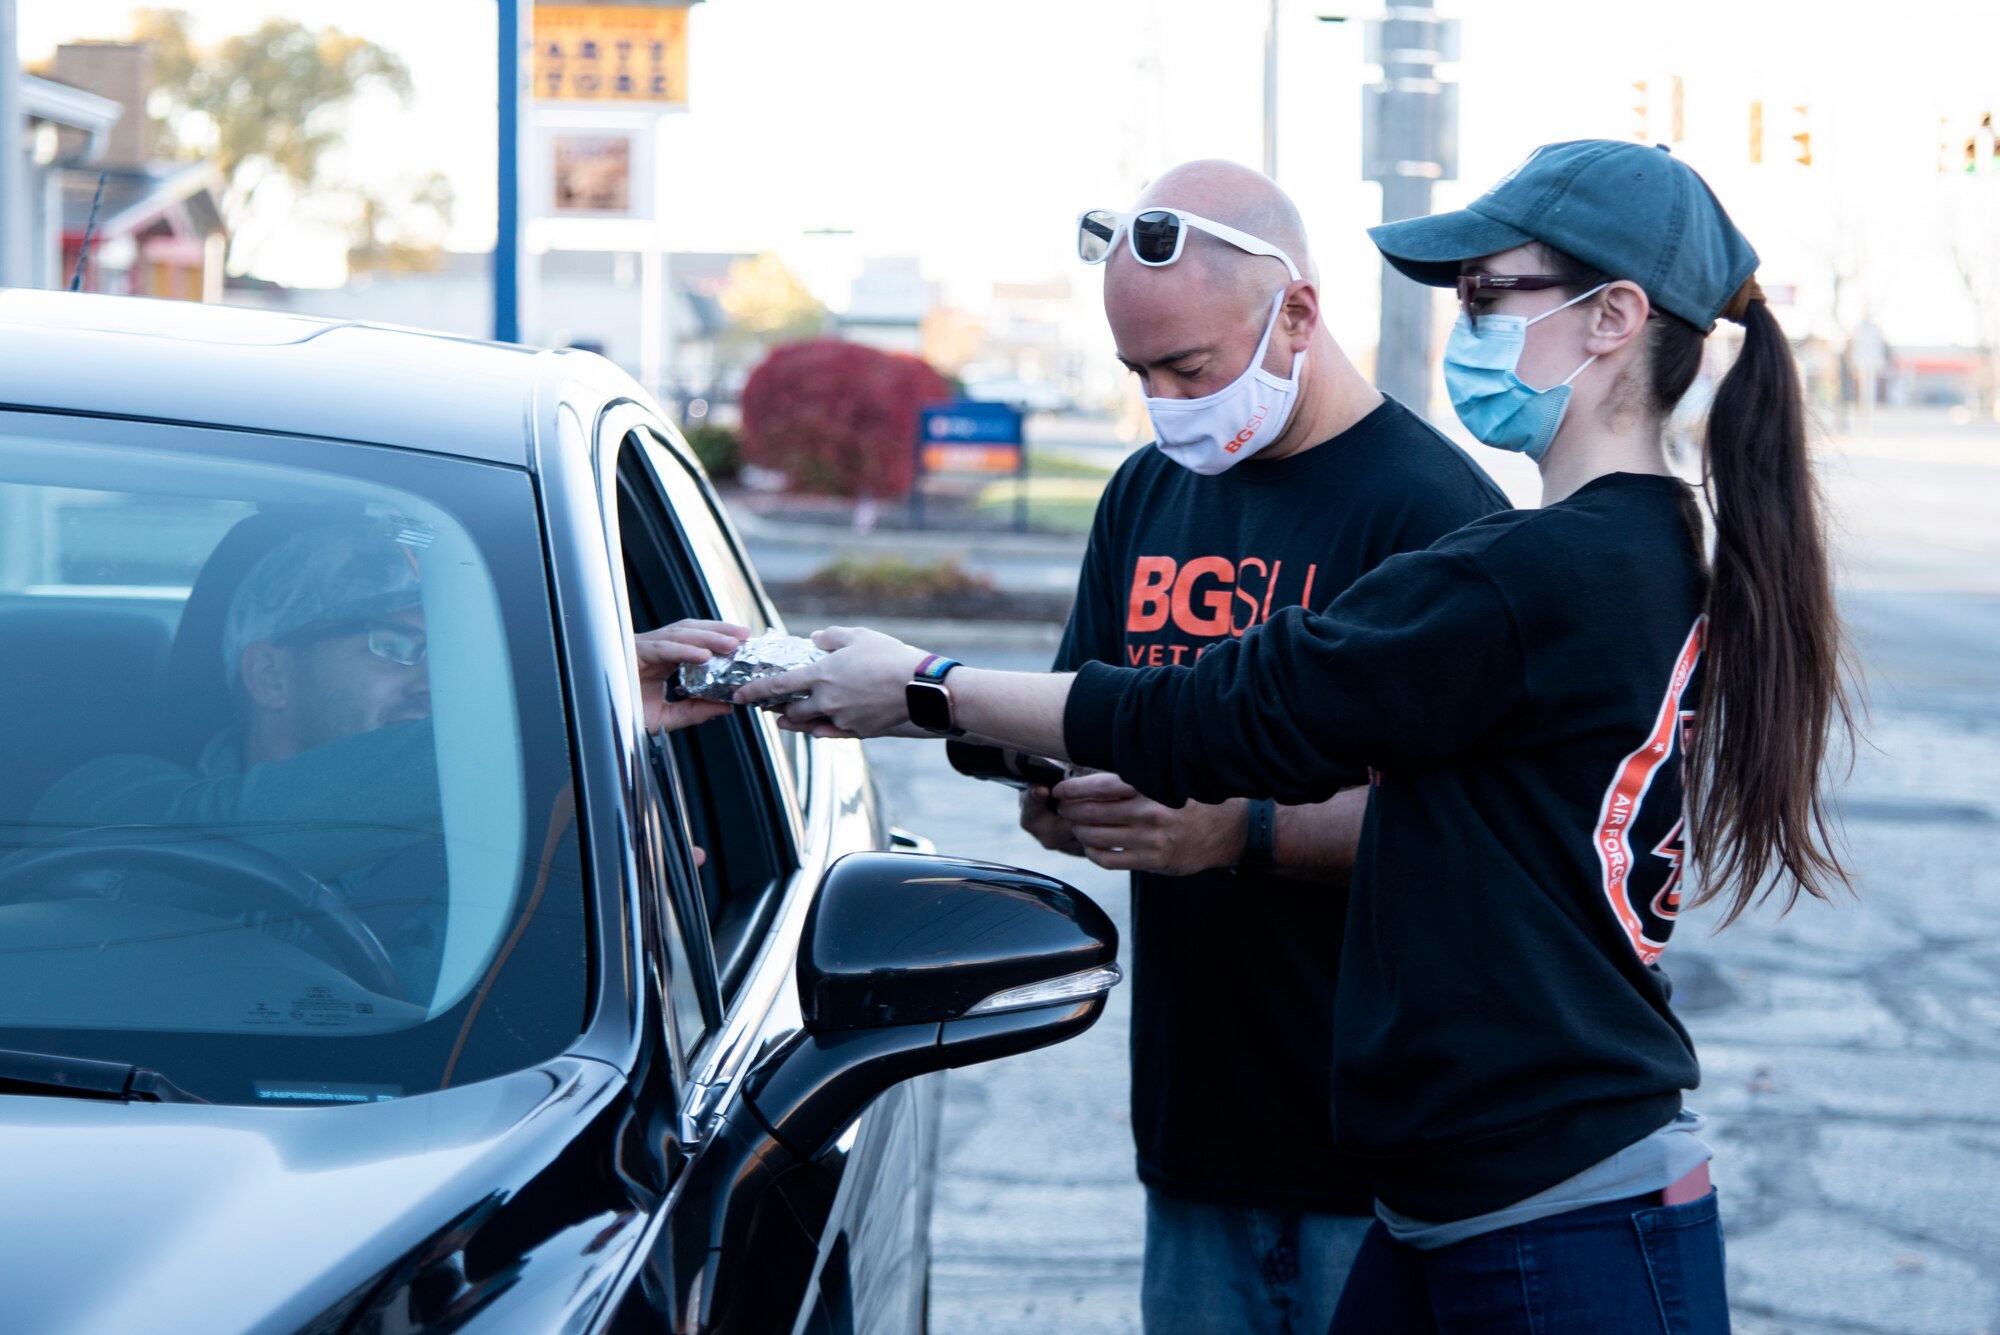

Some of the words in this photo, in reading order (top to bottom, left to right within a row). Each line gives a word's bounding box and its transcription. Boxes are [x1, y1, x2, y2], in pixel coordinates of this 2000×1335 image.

[1224, 406, 1269, 454] BGSU
[1127, 644, 1204, 667] VET
[1608, 793, 1632, 826] AIR
[1603, 828, 1626, 889] FORCE
